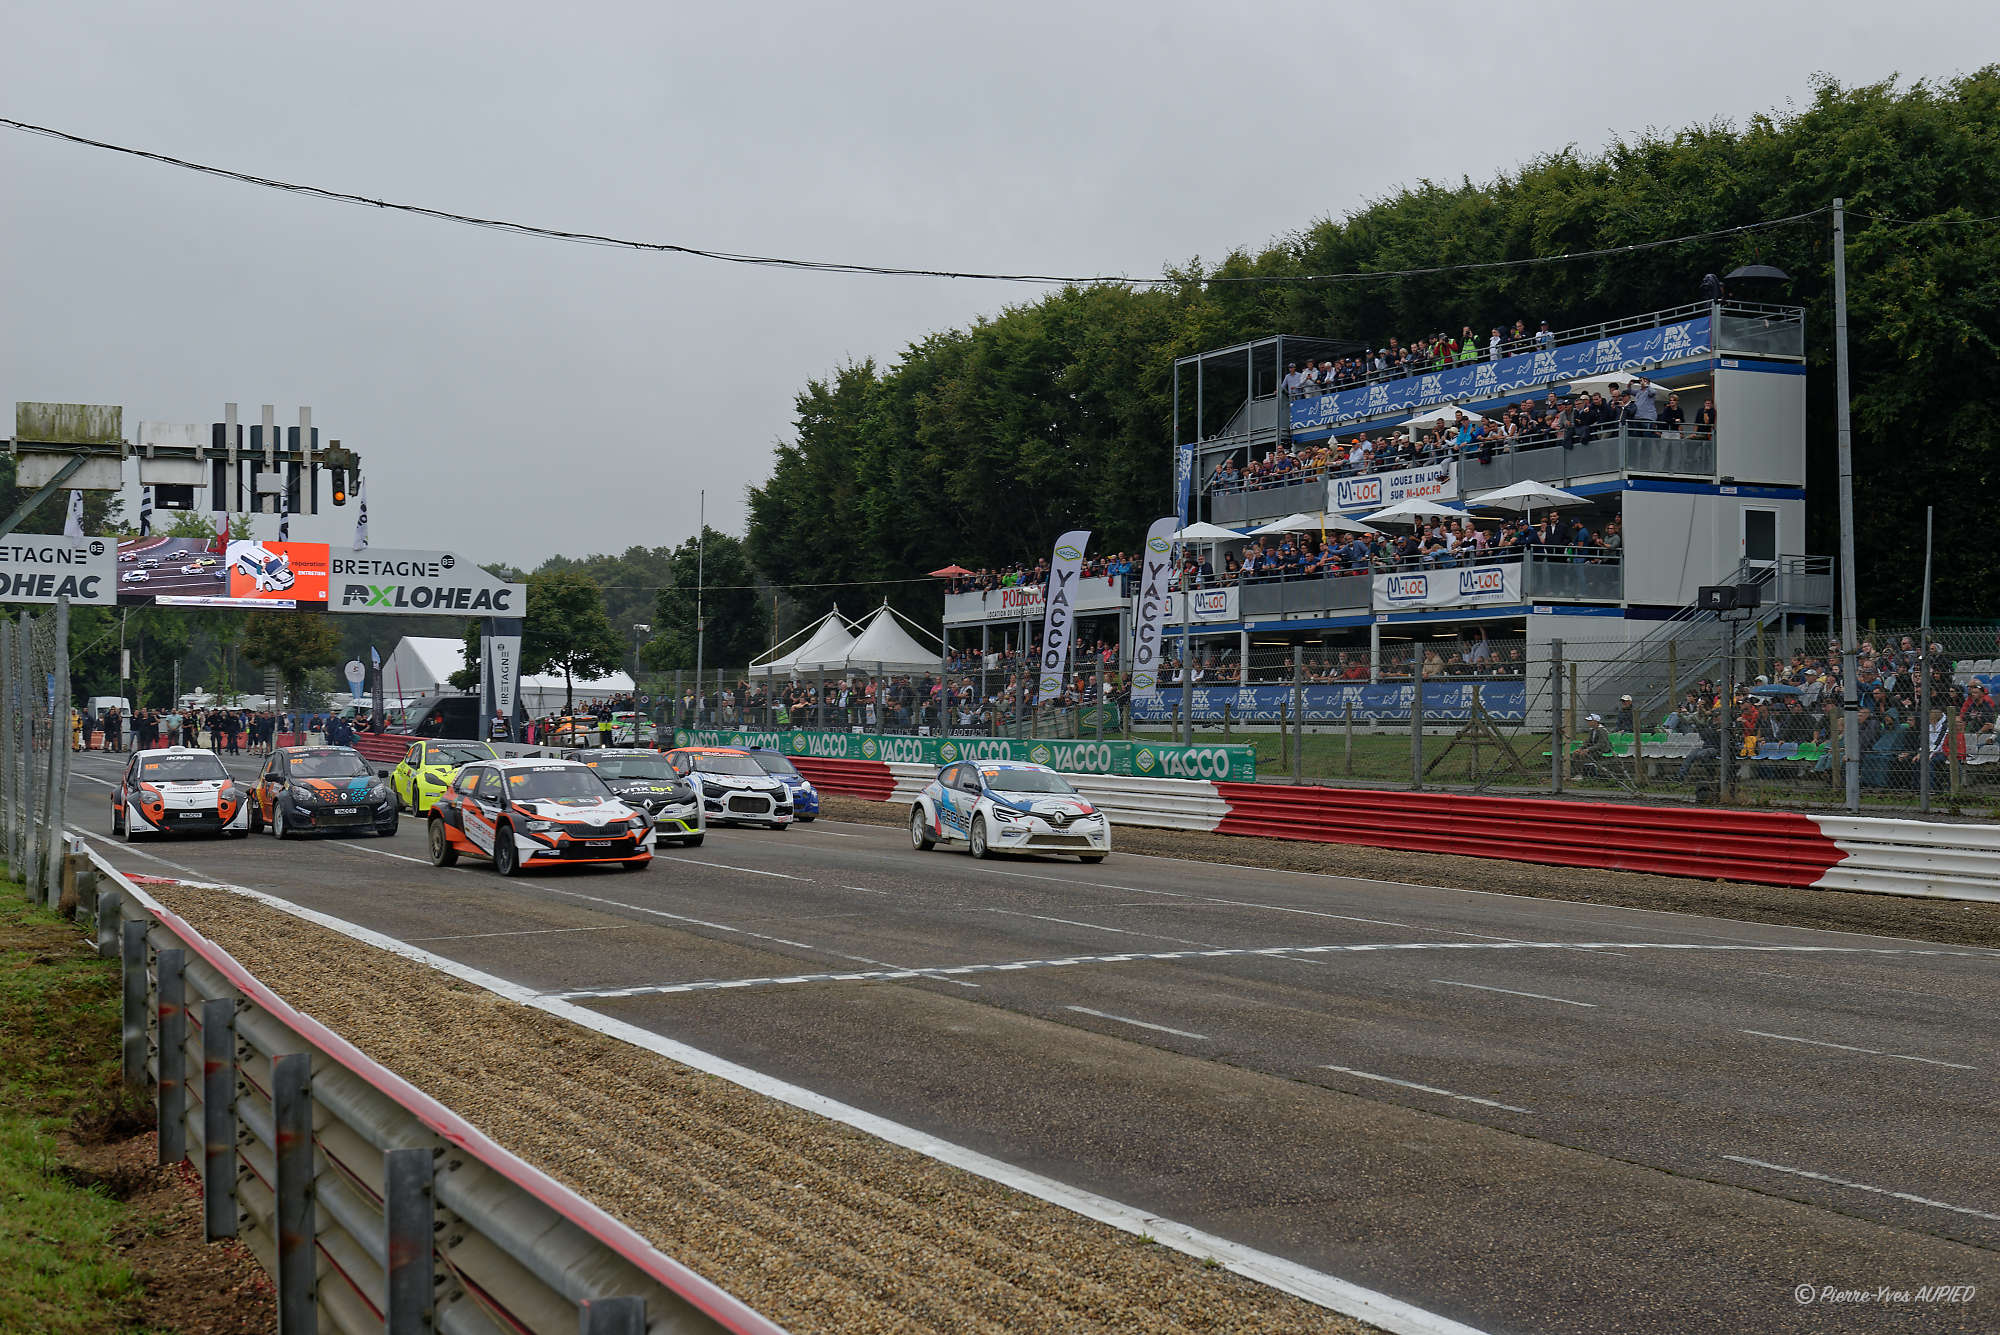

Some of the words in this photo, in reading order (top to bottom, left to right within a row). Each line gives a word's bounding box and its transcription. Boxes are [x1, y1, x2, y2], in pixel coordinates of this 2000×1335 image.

[1390, 475, 1413, 487] LOUEZ
[1415, 473, 1425, 481] EN
[1428, 470, 1450, 481] LIG
[1390, 490, 1404, 500] SUR
[332, 559, 439, 577] BRETAGNE
[1045, 568, 1075, 669] YACCO
[1138, 562, 1165, 665] YACCO
[807, 734, 847, 757] YACCO
[878, 739, 922, 763] YACCO
[1053, 743, 1112, 772] YACCO
[1159, 749, 1230, 779] YACCO
